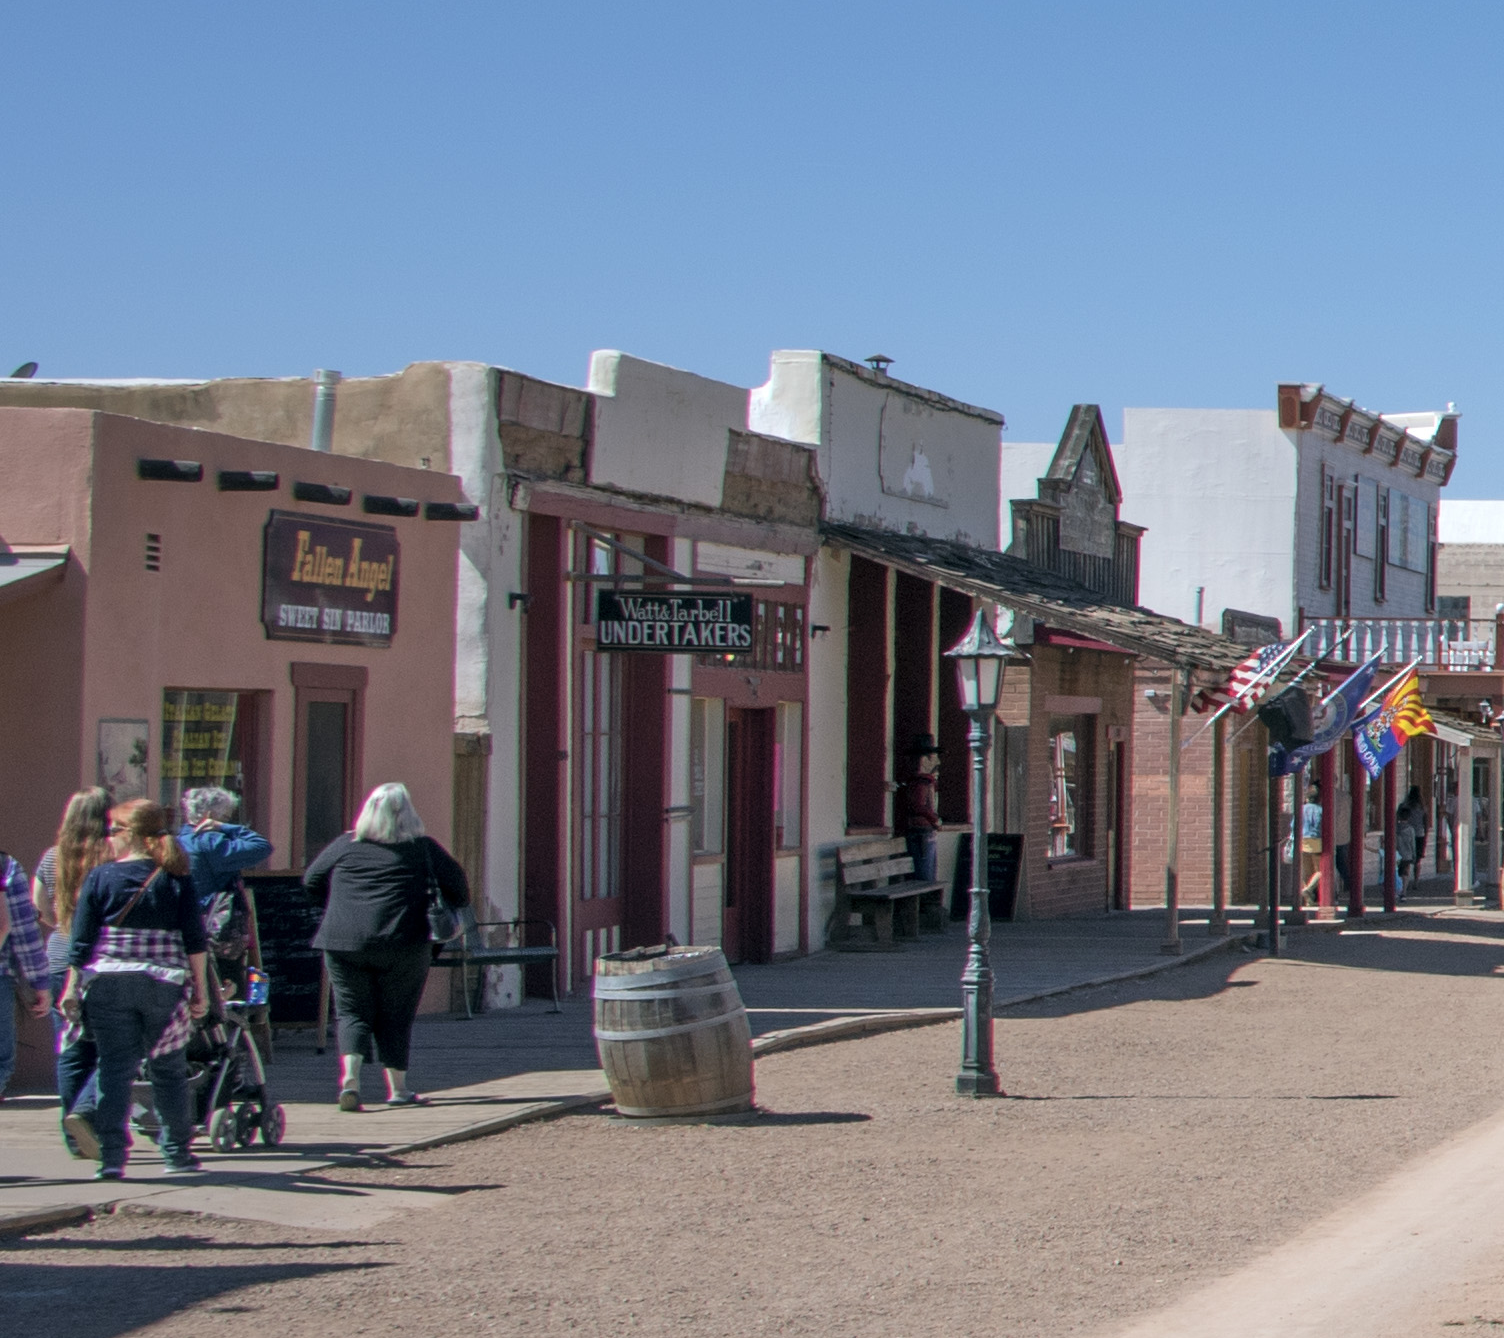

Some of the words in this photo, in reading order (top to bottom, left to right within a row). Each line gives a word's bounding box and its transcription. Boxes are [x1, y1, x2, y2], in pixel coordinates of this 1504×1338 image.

[291, 529, 344, 586] Fallen
[345, 537, 394, 602] Angel
[278, 604, 320, 629] SWEET
[322, 607, 342, 631] SIN
[344, 609, 390, 635] PARLOR
[600, 620, 751, 647] UNDERTAKERS
